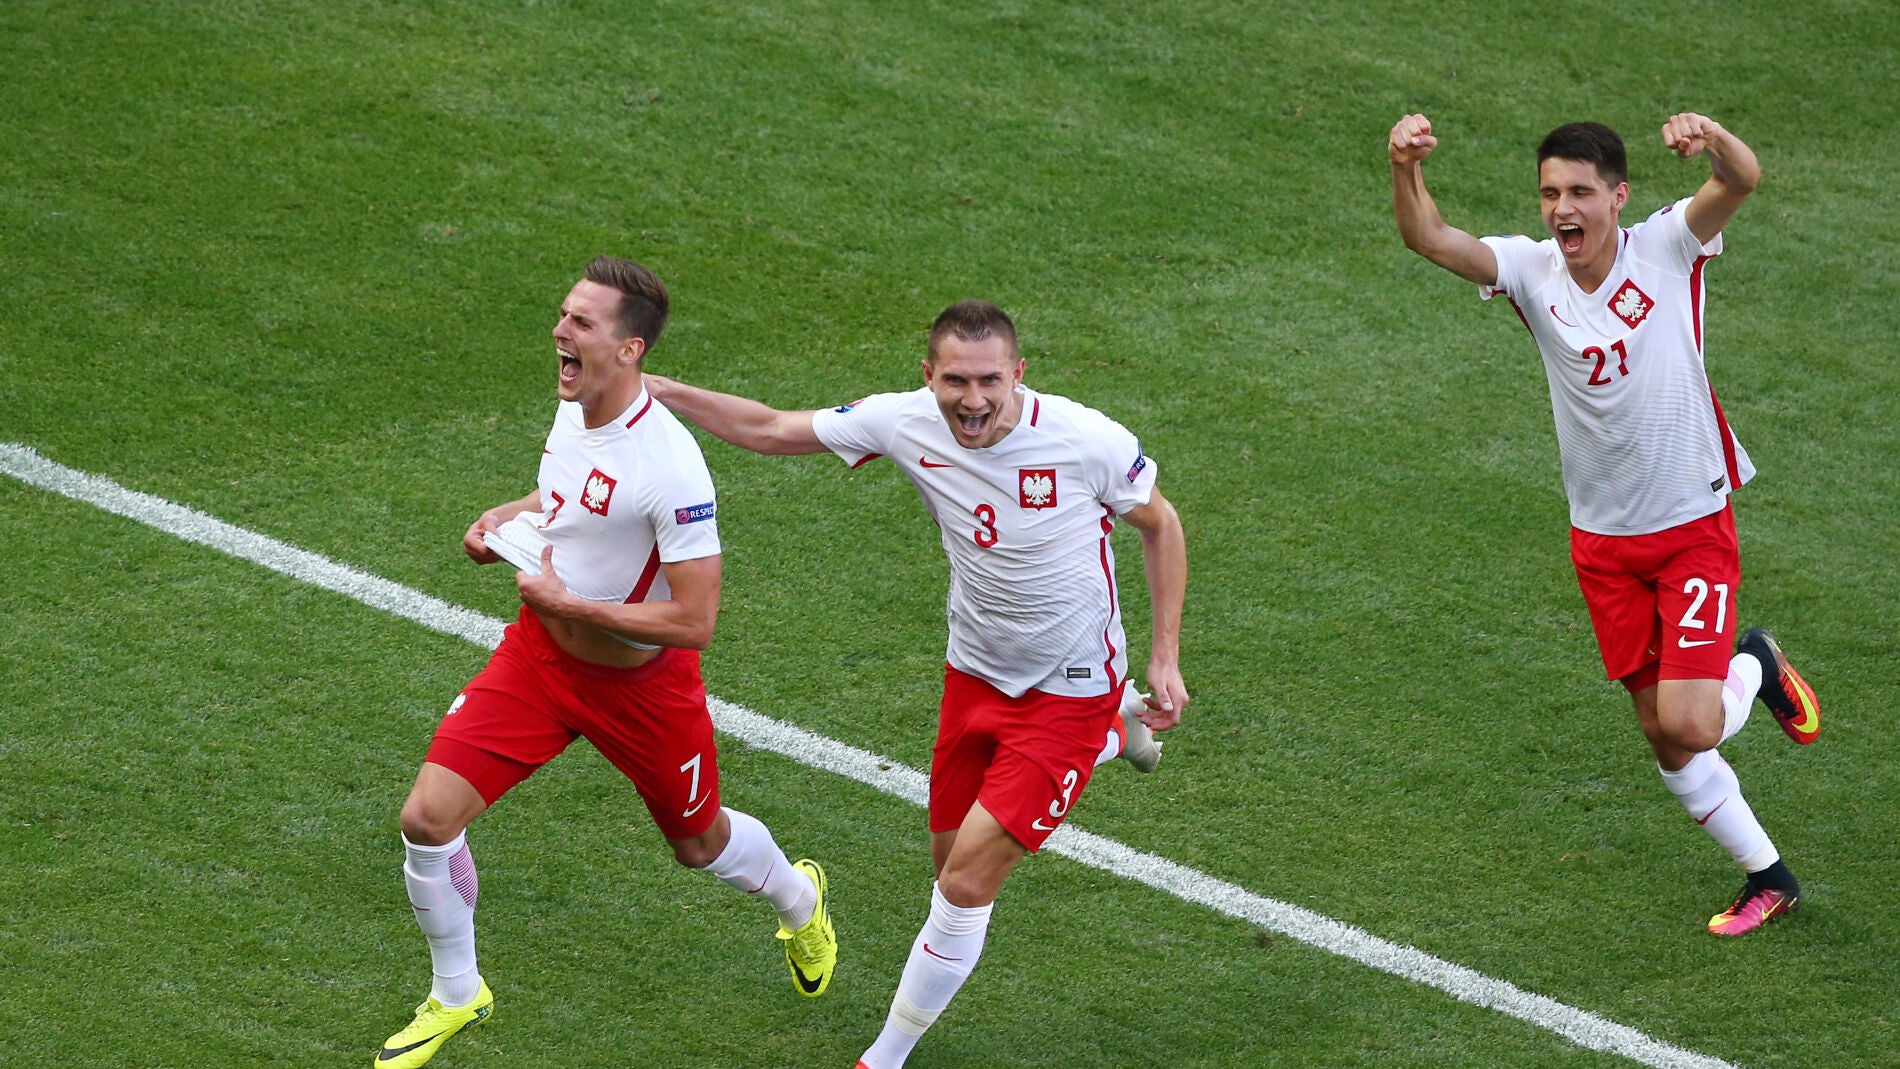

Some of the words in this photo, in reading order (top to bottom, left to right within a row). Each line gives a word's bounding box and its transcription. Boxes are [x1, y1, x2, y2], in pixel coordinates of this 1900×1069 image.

[1582, 339, 1629, 385] 21
[538, 490, 565, 528] 7
[690, 506, 714, 519] RESPEC
[974, 504, 998, 548] 3
[1678, 577, 1728, 633] 21
[680, 752, 701, 803] 7
[1049, 769, 1078, 817] 3
